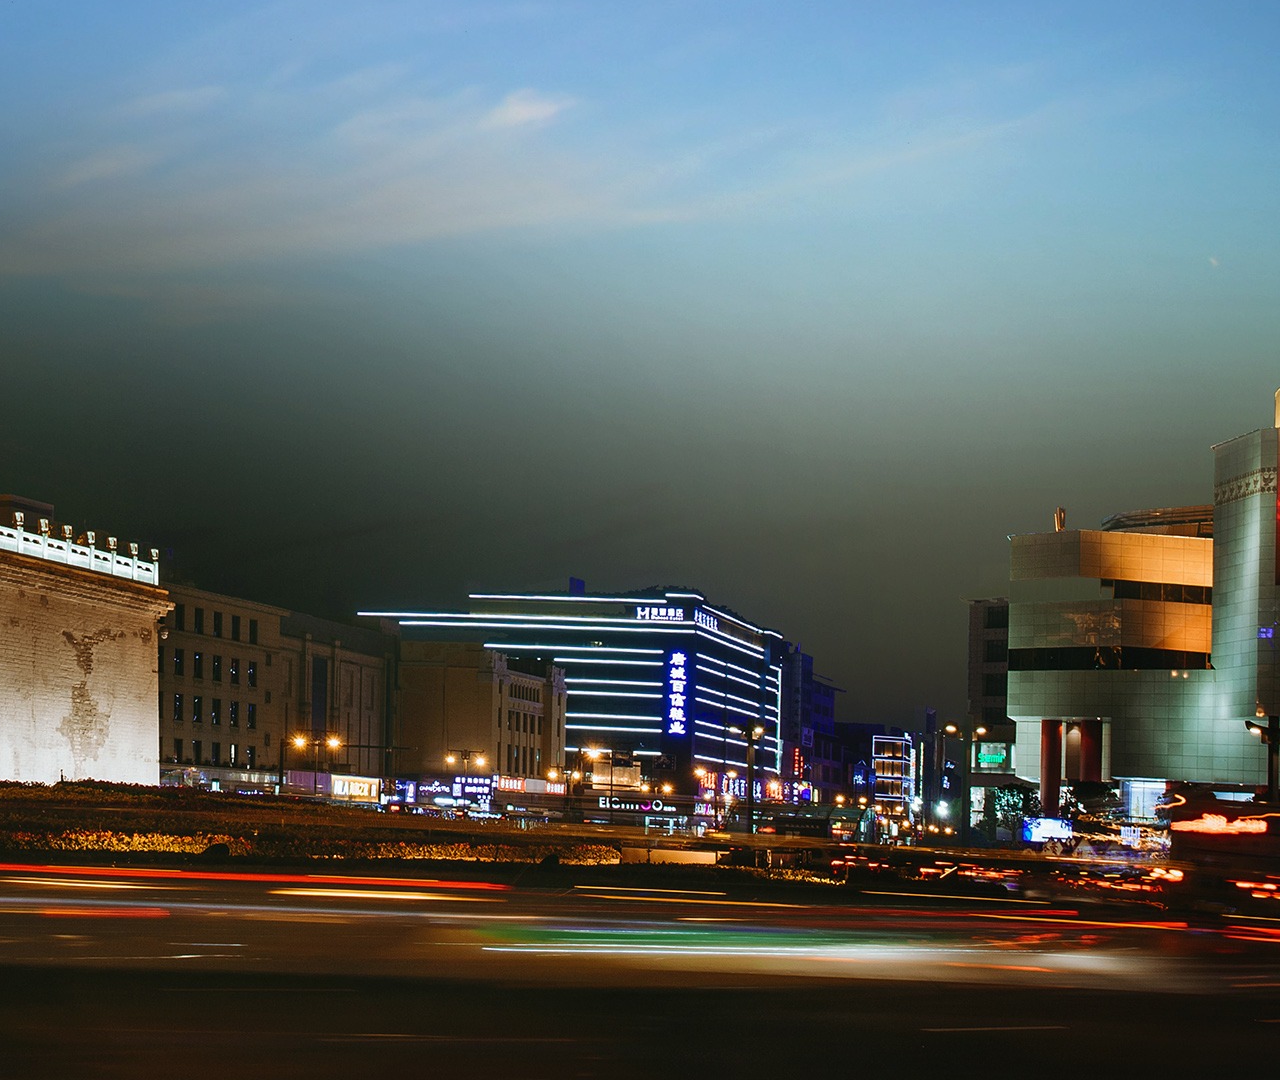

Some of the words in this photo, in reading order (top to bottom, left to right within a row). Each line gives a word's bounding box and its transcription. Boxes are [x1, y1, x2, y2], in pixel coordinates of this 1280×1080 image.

[669, 652, 687, 734] 唐城百信鞋业
